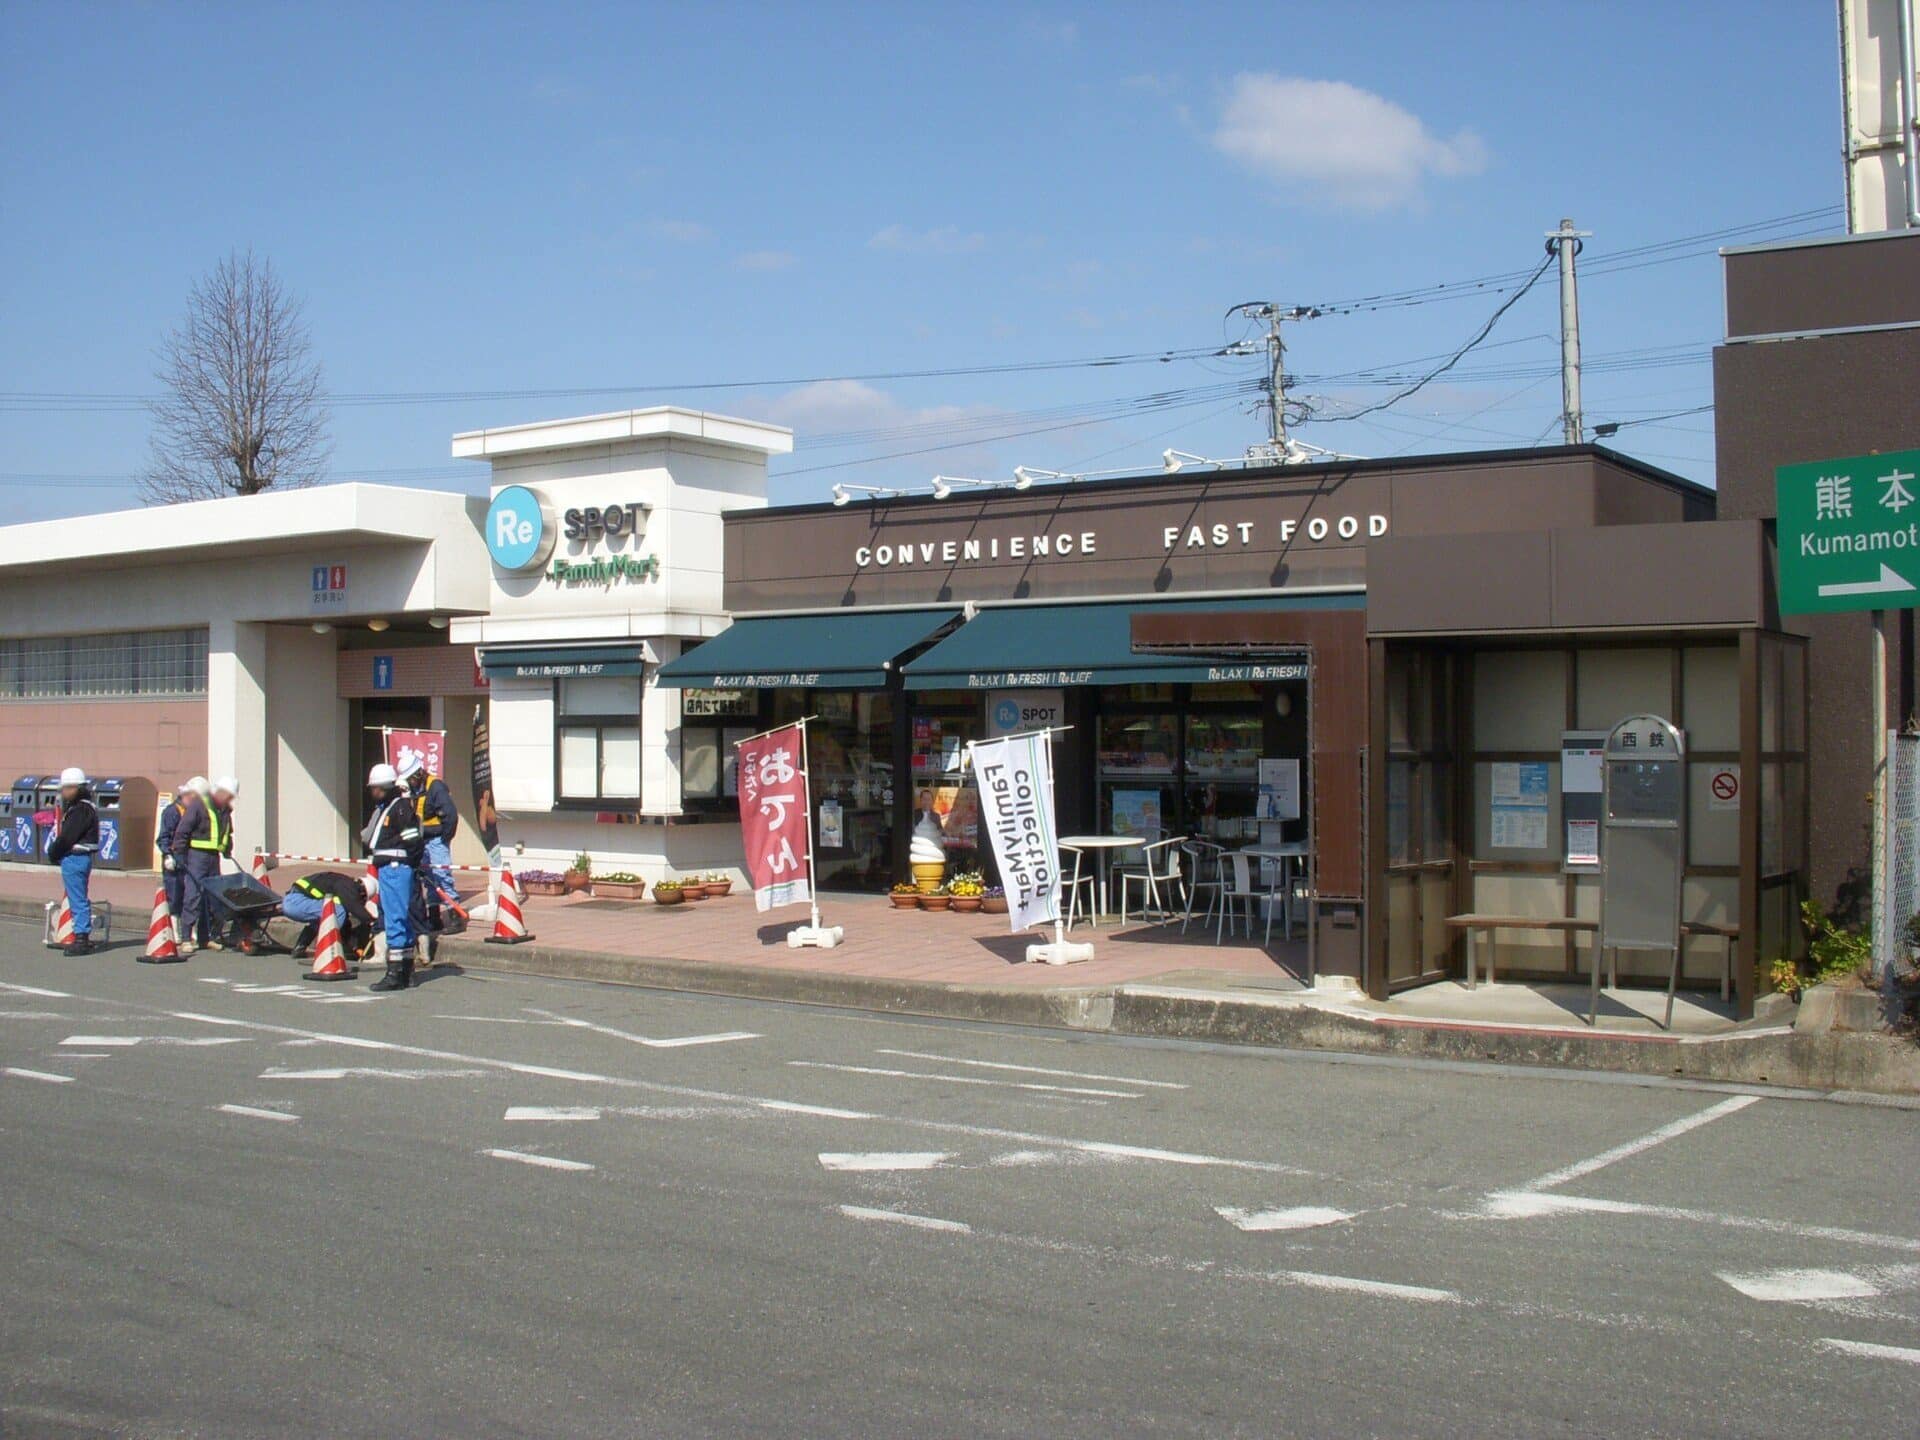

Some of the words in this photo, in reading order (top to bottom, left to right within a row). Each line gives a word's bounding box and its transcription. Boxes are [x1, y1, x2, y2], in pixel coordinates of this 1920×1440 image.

[1816, 468, 1915, 520] 熊本
[496, 509, 533, 547] Re
[564, 502, 650, 540] SPOT
[1164, 523, 1253, 548] FAST
[1281, 515, 1387, 542] FOOD
[856, 532, 1096, 567] CONVENIENCE
[553, 554, 659, 583] FamilyMart
[713, 676, 740, 687] ReLAX
[745, 675, 783, 686] ReFRESH
[789, 674, 819, 685] ReLIEF
[968, 674, 1000, 687] ReLAX
[1006, 673, 1049, 685] ReFRESH
[1058, 671, 1092, 684] ReLIEF
[1208, 667, 1243, 680] ReLAX
[1252, 665, 1301, 678] ReFRESH
[1022, 708, 1056, 721] SPOT
[1622, 732, 1664, 747] 西鉄
